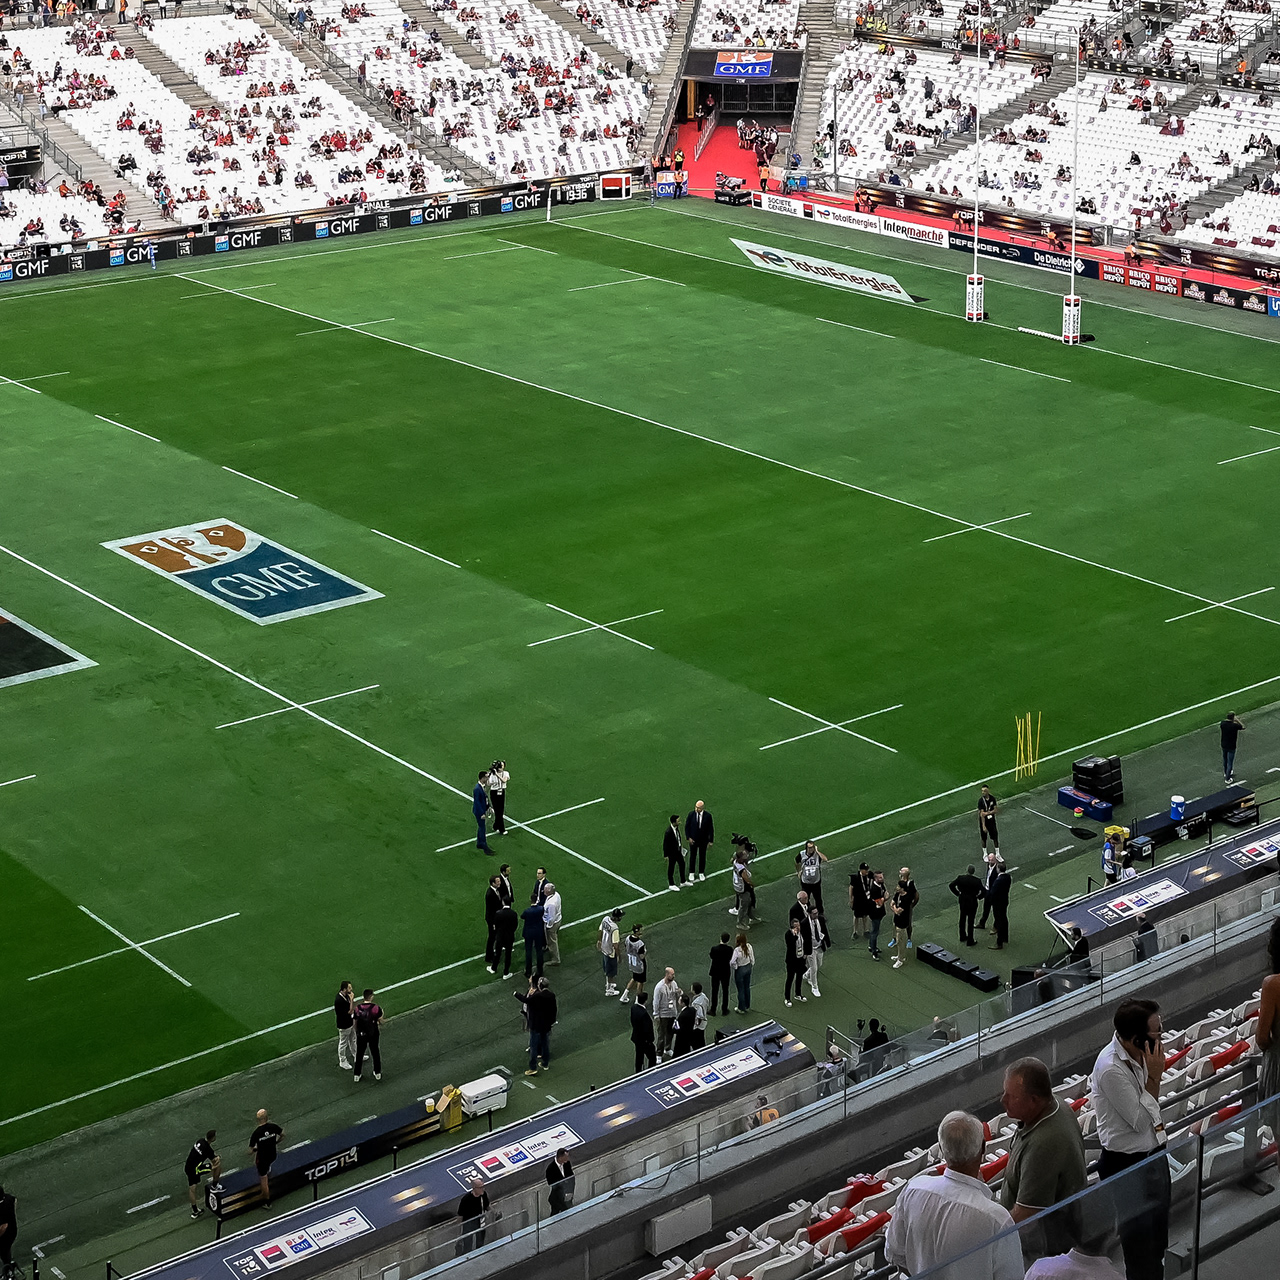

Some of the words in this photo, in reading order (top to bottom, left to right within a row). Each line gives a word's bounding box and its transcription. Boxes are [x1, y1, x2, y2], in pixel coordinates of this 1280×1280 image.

[720, 64, 767, 75] GMF
[362, 200, 391, 211] FINALE
[515, 194, 541, 209] GMF
[767, 196, 792, 207] SOCIETE
[425, 206, 452, 221] GMF
[768, 202, 797, 214] GENERALE
[832, 211, 878, 229] TotalEnergies
[331, 219, 360, 234] GMF
[883, 220, 944, 242] Intermarché
[232, 232, 261, 248] GMF
[950, 237, 1000, 254] DEFENDER
[1034, 252, 1045, 263] De
[1045, 253, 1073, 267] Dietrich
[16, 260, 49, 277] GMF
[1103, 265, 1124, 275] BRICO
[785, 257, 902, 294] TotalEnergies
[1129, 270, 1150, 280] BRICO
[1155, 275, 1177, 285] BRICO
[1184, 289, 1205, 300] ANDROS
[1213, 294, 1235, 306] ANDROS
[1243, 301, 1265, 312] ANDROS
[211, 562, 321, 601] GMF
[527, 1141, 547, 1151] Inter
[510, 1153, 525, 1163] GMF
[305, 1152, 358, 1180] TOP14
[456, 1166, 475, 1176] TOP
[313, 1228, 333, 1239] Inter
[292, 1241, 309, 1253] GMF
[233, 1255, 253, 1267] TOP
[241, 1265, 261, 1275] 14
